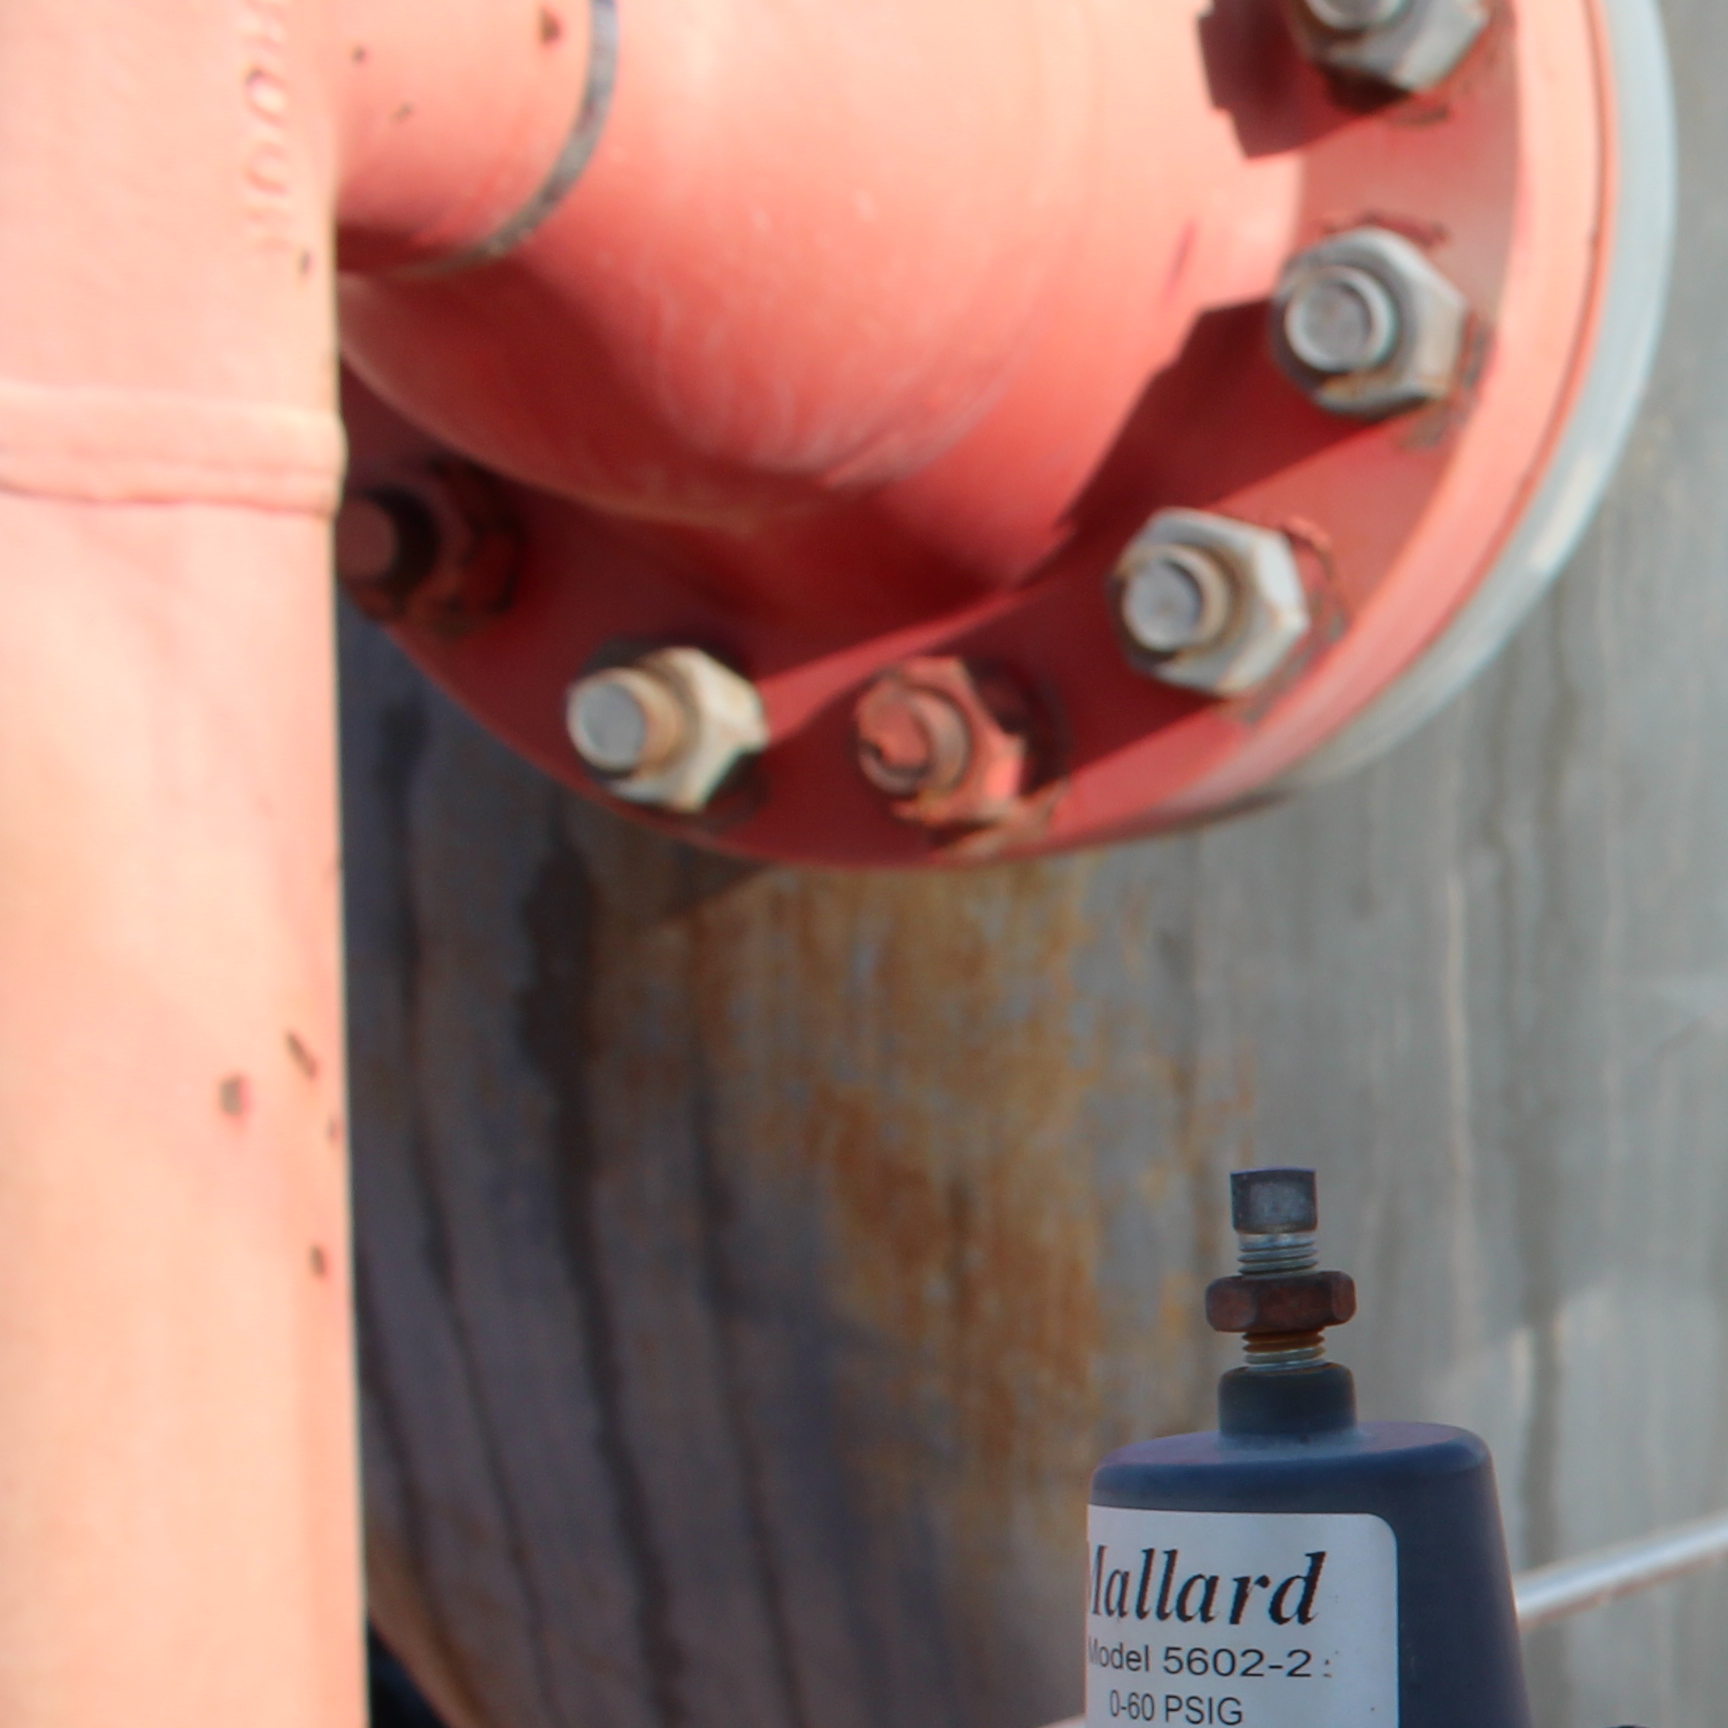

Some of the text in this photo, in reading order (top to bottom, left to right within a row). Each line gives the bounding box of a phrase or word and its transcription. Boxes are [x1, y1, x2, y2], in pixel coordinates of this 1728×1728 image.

[1090, 1543, 1327, 1626] allard
[1109, 1689, 1244, 1726] 0-60 PSIG
